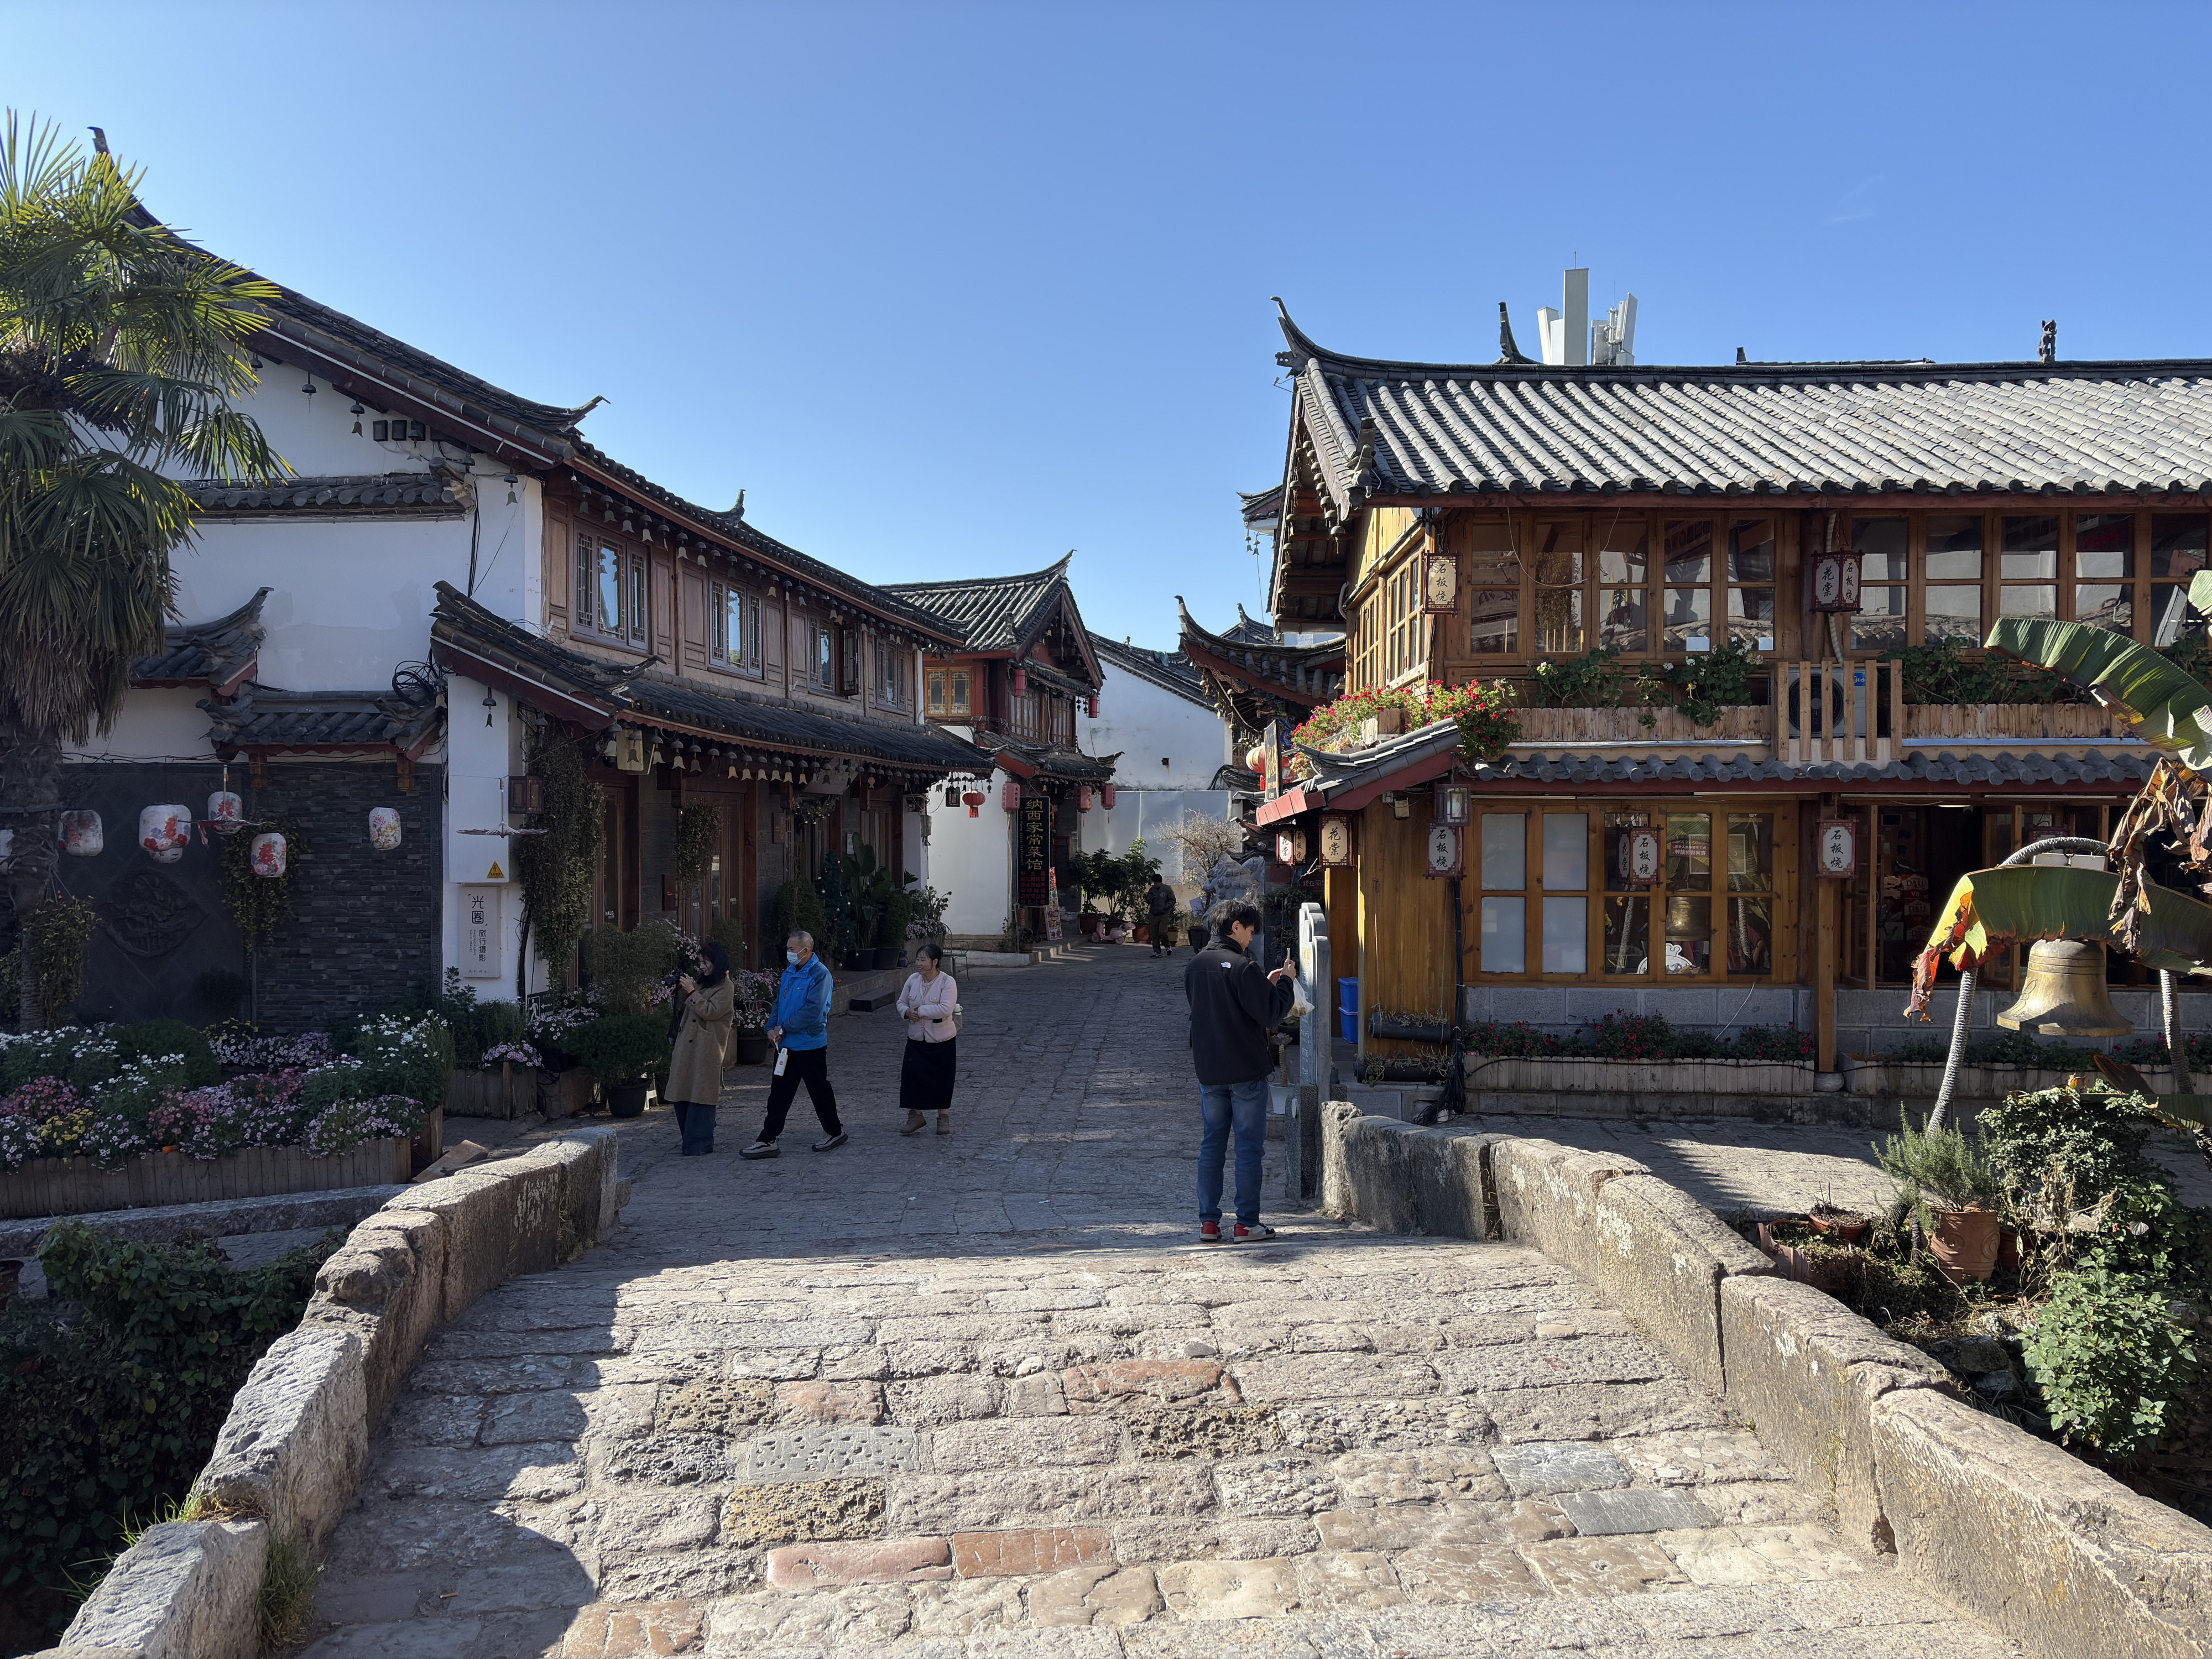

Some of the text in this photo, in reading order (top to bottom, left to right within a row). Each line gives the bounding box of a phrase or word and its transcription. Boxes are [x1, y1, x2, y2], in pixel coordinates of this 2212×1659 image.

[1436, 564, 1448, 601] 石板烧
[1025, 799, 1044, 870] 纳西家常菜馆
[1436, 830, 1448, 867] 石板烧
[1830, 830, 1844, 868] 石板烧
[1639, 837, 1650, 874] 石板烧
[472, 895, 484, 924] 光圈
